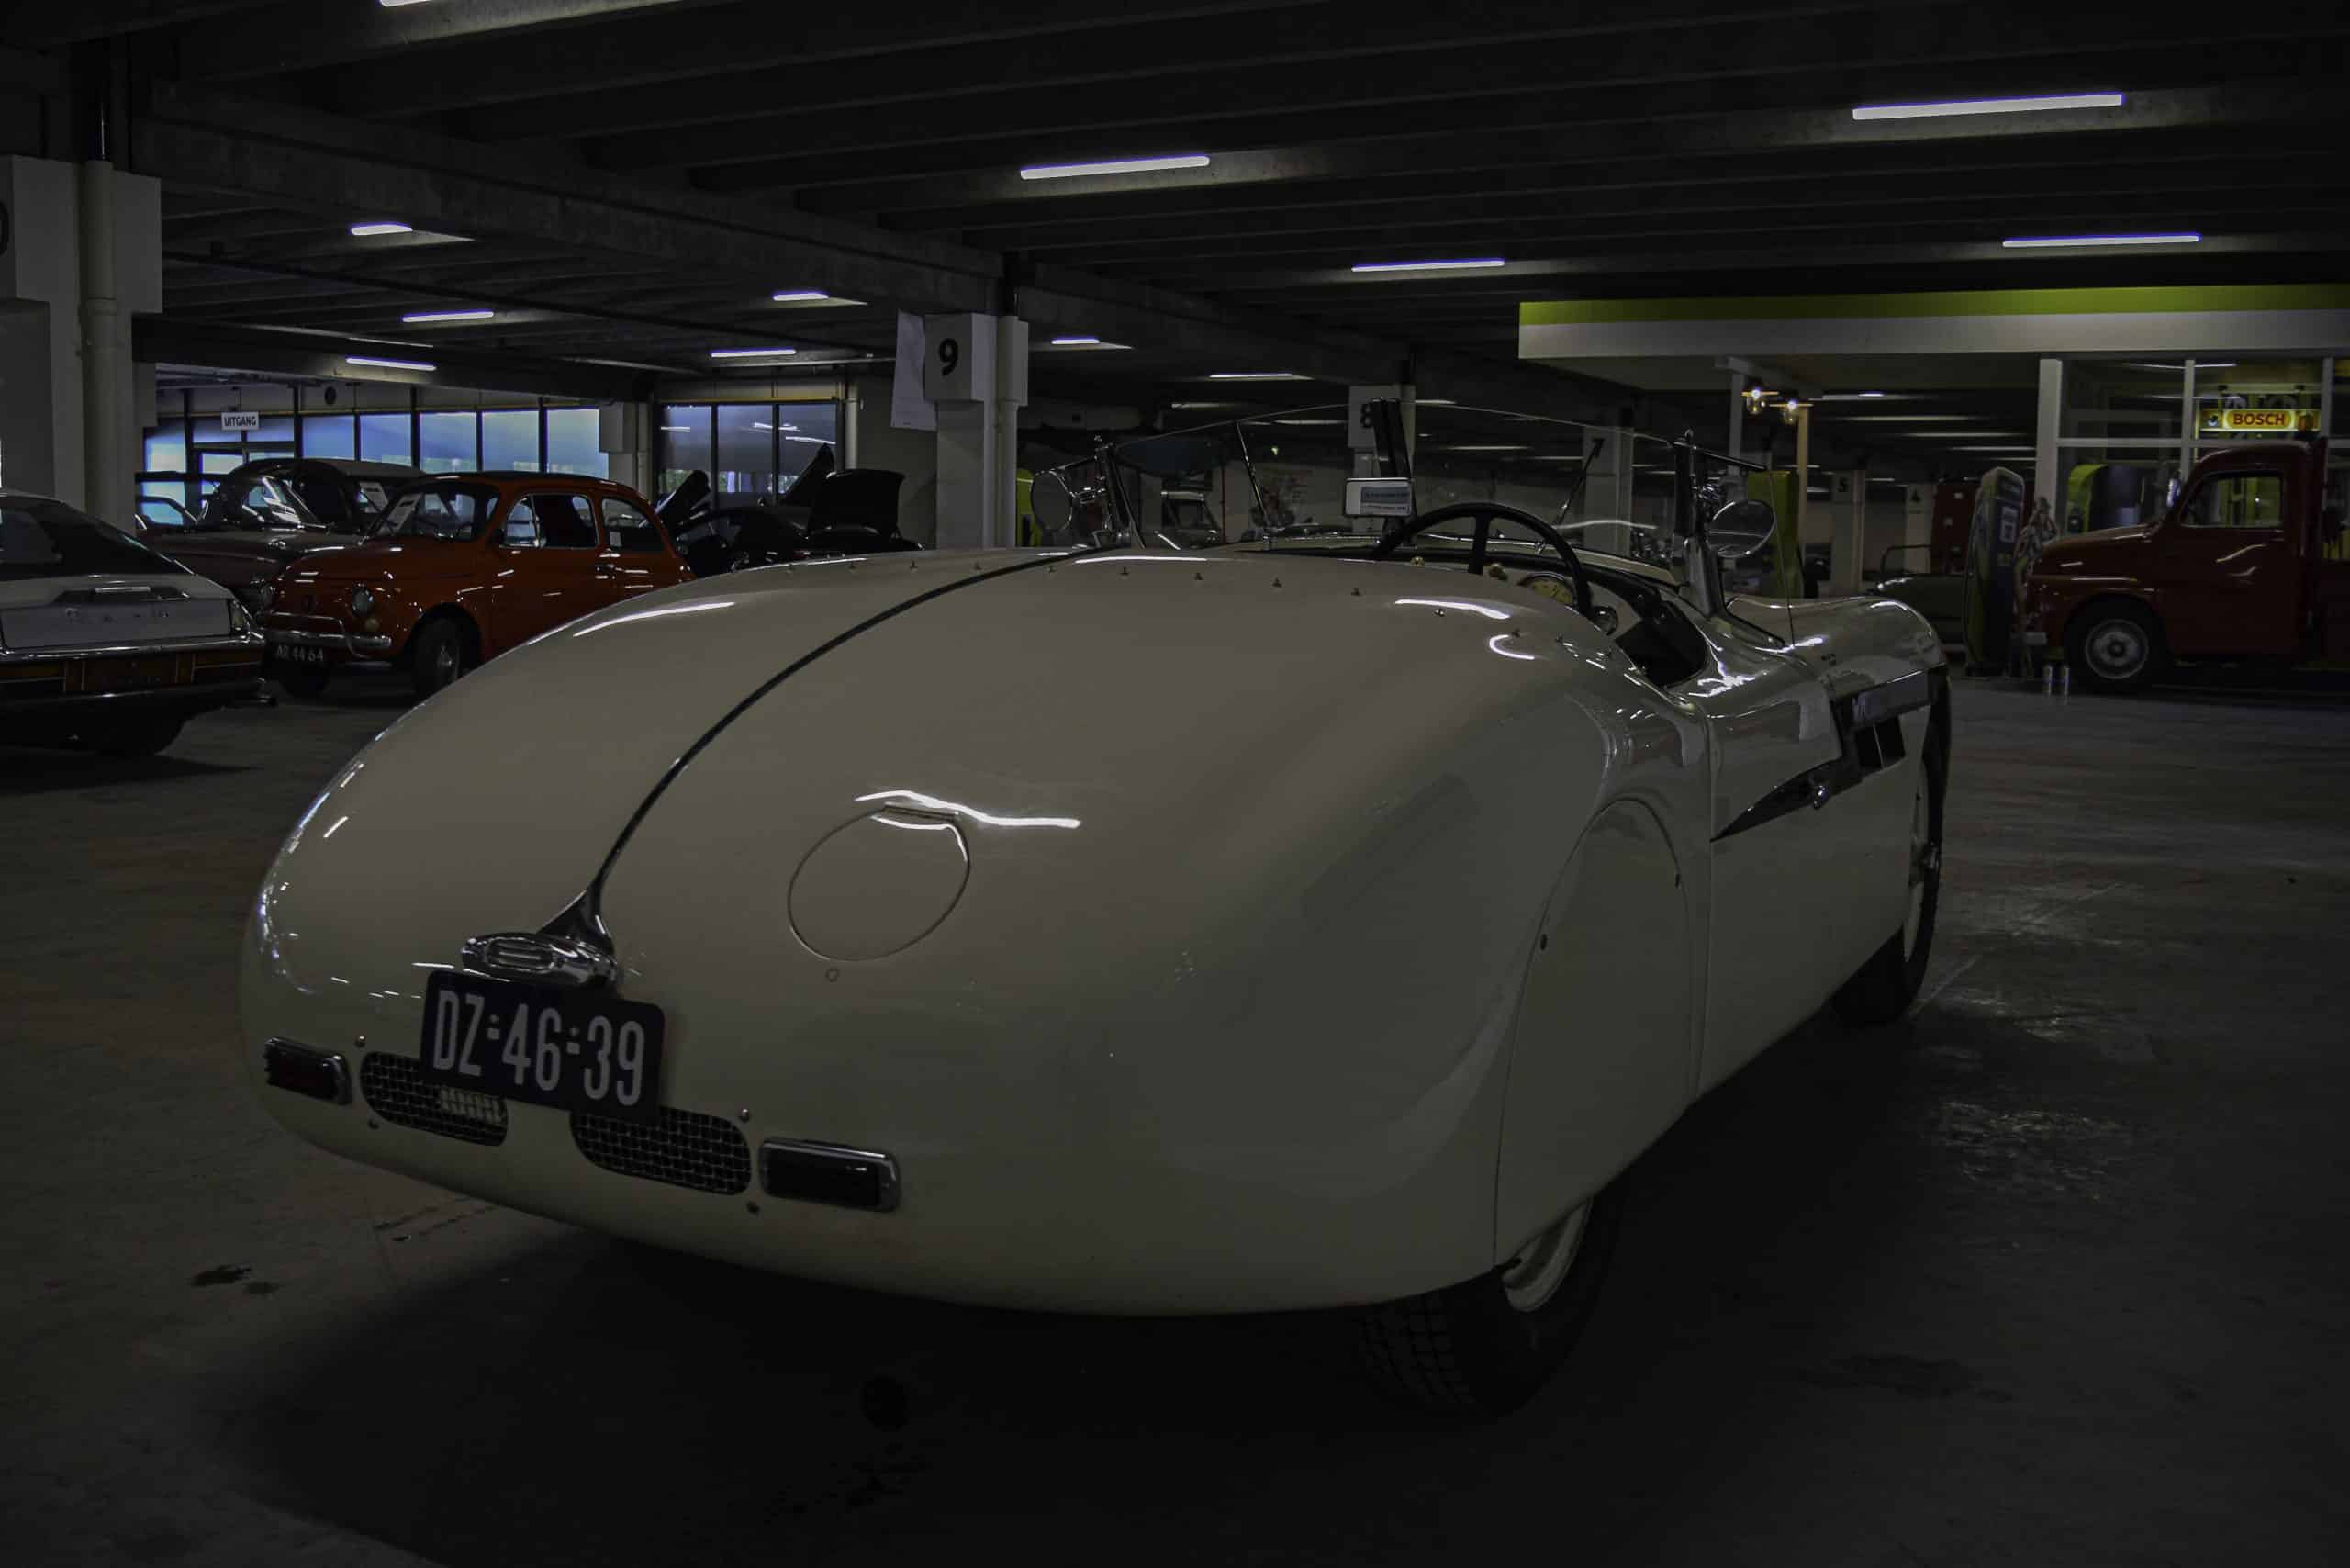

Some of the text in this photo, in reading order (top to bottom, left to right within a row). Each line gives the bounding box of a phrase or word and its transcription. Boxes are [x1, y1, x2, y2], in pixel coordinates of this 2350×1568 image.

[939, 338, 958, 375] 9
[224, 416, 256, 427] UITGANG
[2233, 413, 2285, 426] BOSCH
